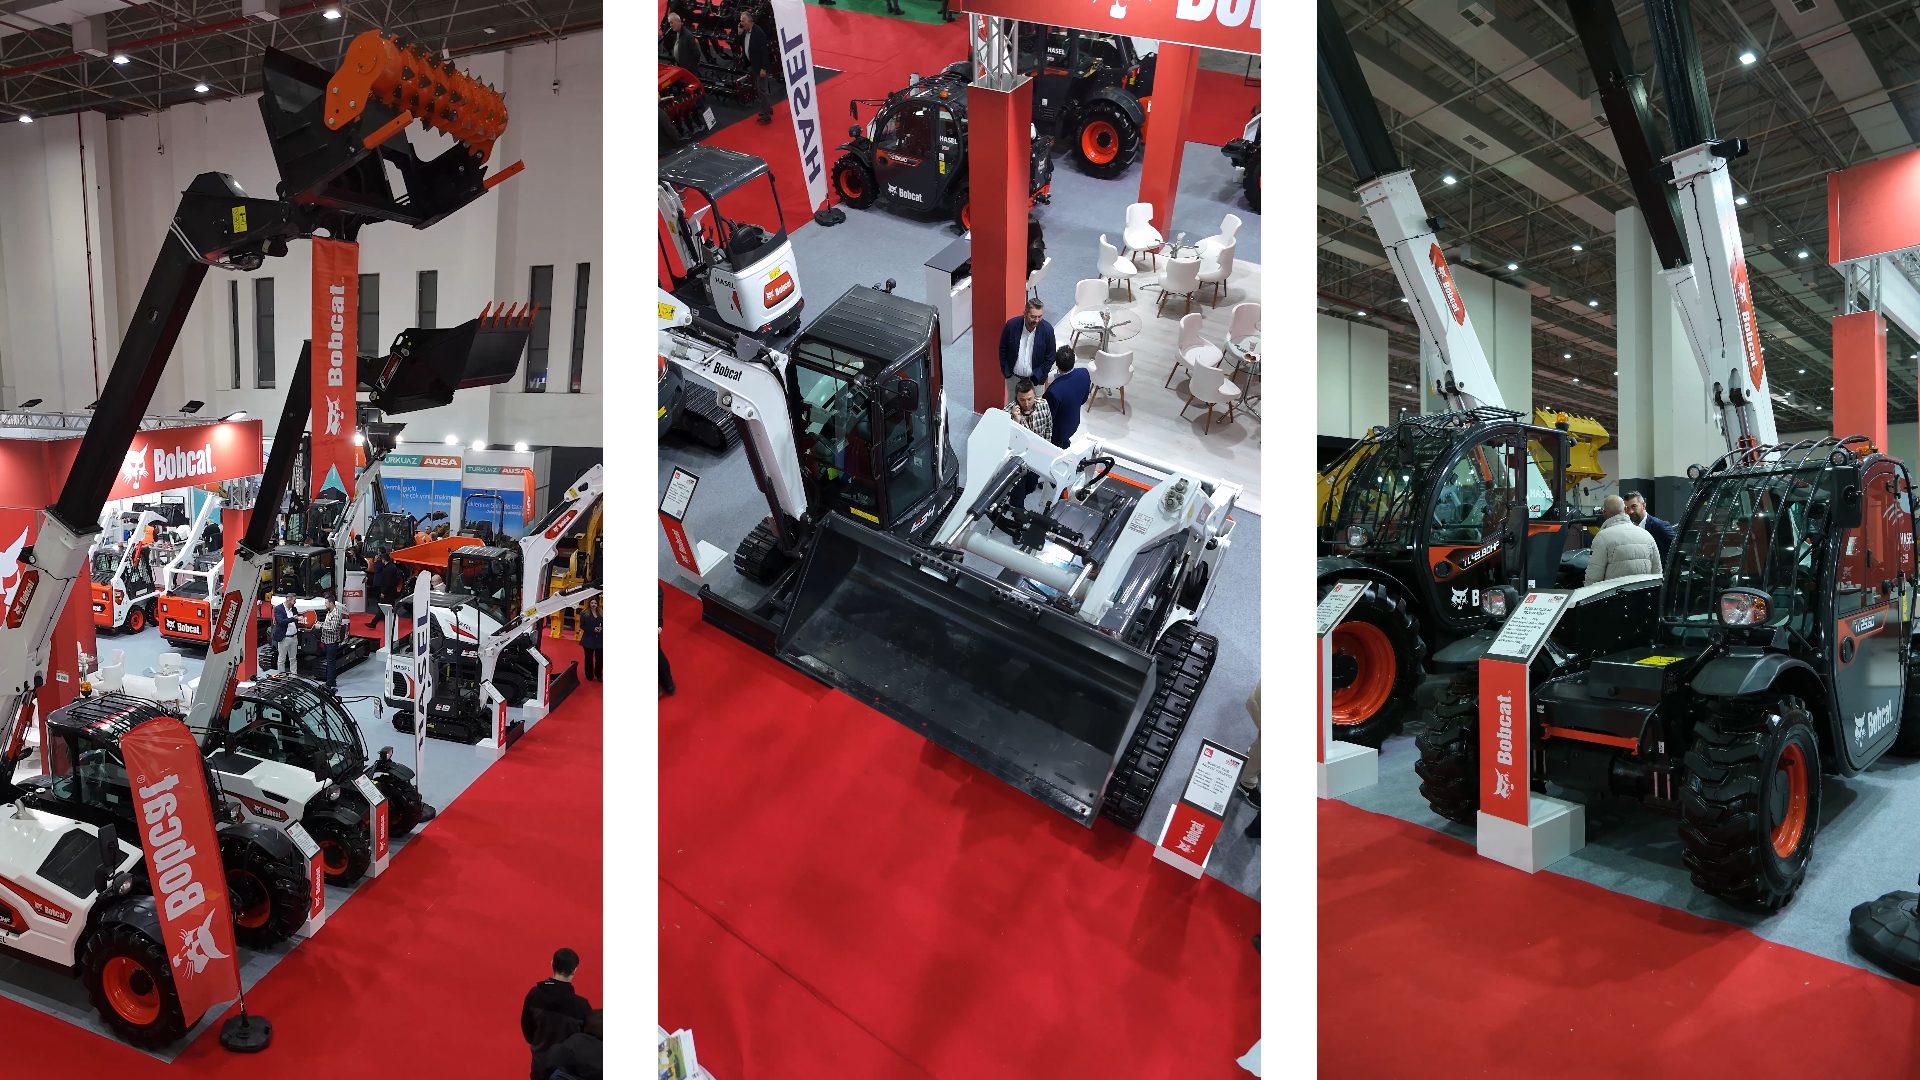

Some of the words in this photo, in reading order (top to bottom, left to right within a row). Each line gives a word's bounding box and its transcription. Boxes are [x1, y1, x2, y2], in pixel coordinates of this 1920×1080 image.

[1047, 46, 1066, 56] HASEL
[939, 135, 958, 145] HASEL
[898, 187, 924, 203] Bobcat
[1442, 281, 1461, 313] Bobcat
[327, 283, 346, 387] Bobcat
[1741, 311, 1760, 370] Bobcat
[712, 361, 743, 383] Bobcat
[153, 443, 214, 483] Bobcat
[383, 455, 418, 466] URKUAZ
[424, 458, 458, 467] AUSA
[19, 578, 36, 606] Bobcat
[176, 622, 201, 635] Bobcat
[223, 600, 239, 629] Bobcat
[417, 600, 429, 752] HASEL
[1496, 694, 1512, 766] Bobcat
[1867, 705, 1894, 739] Bobcat
[261, 806, 282, 819] Bobcat
[1183, 819, 1206, 847] Bobcat
[44, 905, 67, 920] Bobcat
